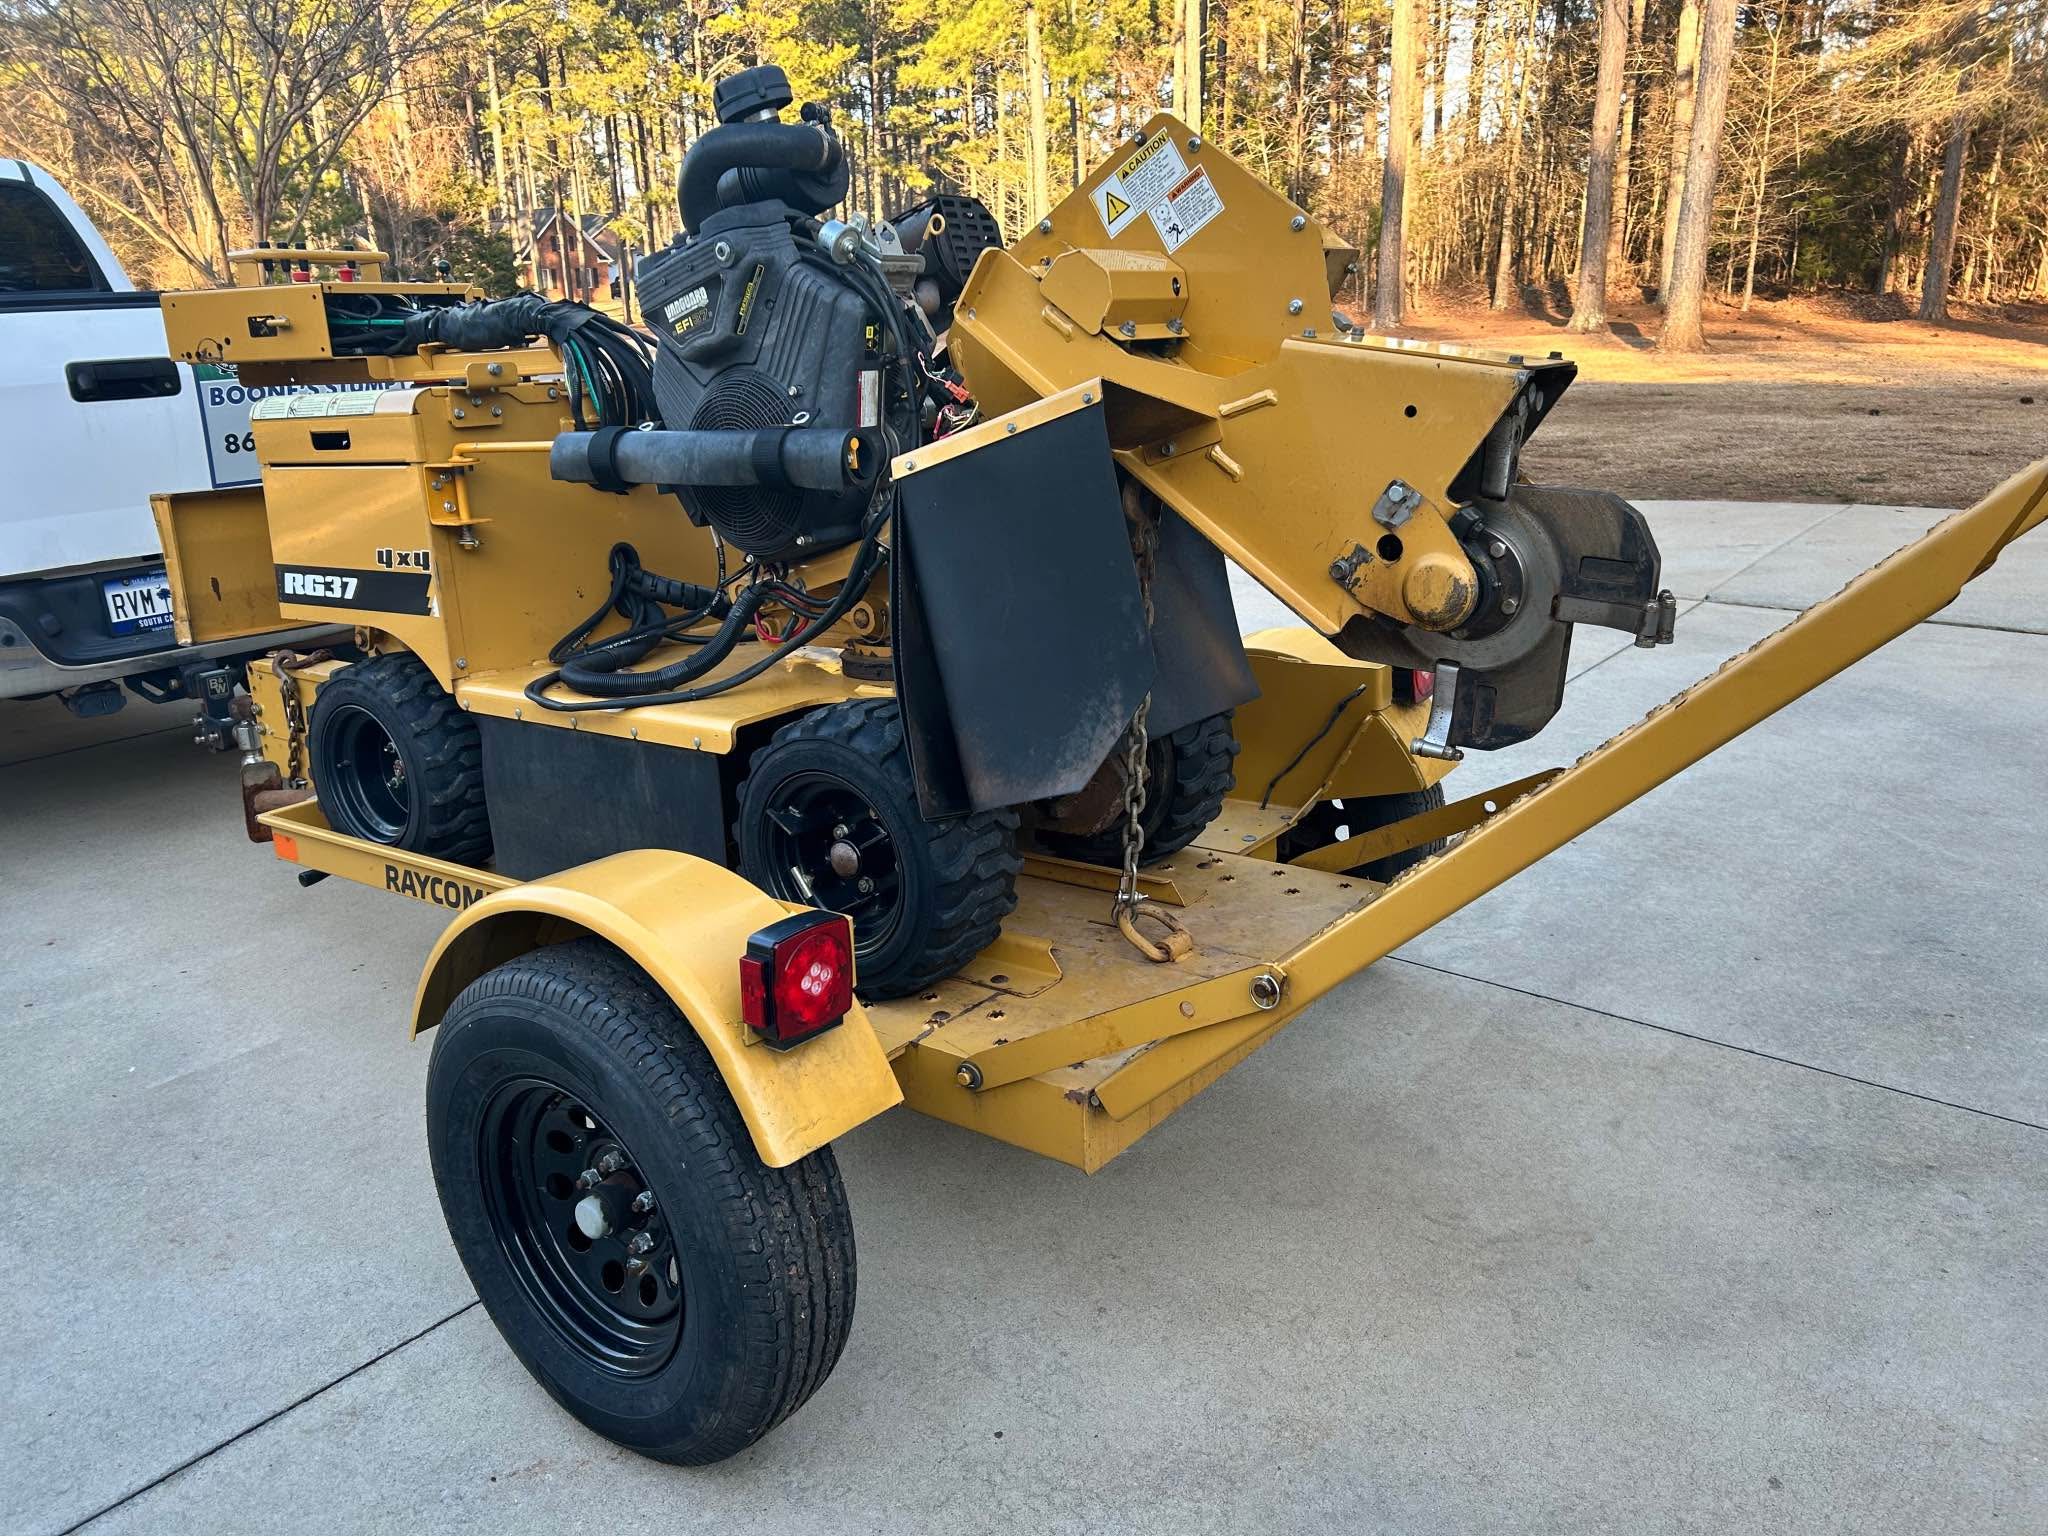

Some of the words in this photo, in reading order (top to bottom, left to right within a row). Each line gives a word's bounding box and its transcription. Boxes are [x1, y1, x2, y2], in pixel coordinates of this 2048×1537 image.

[1128, 133, 1167, 172] CAUTION
[1175, 171, 1201, 194] WARNING
[664, 286, 709, 321] VANGUARD
[675, 316, 694, 335] EFI
[376, 548, 431, 572] 4x4
[284, 572, 358, 600] RG37
[112, 588, 156, 619] RVM
[139, 615, 163, 628] SOUTH
[385, 864, 492, 912] RAYCOM
